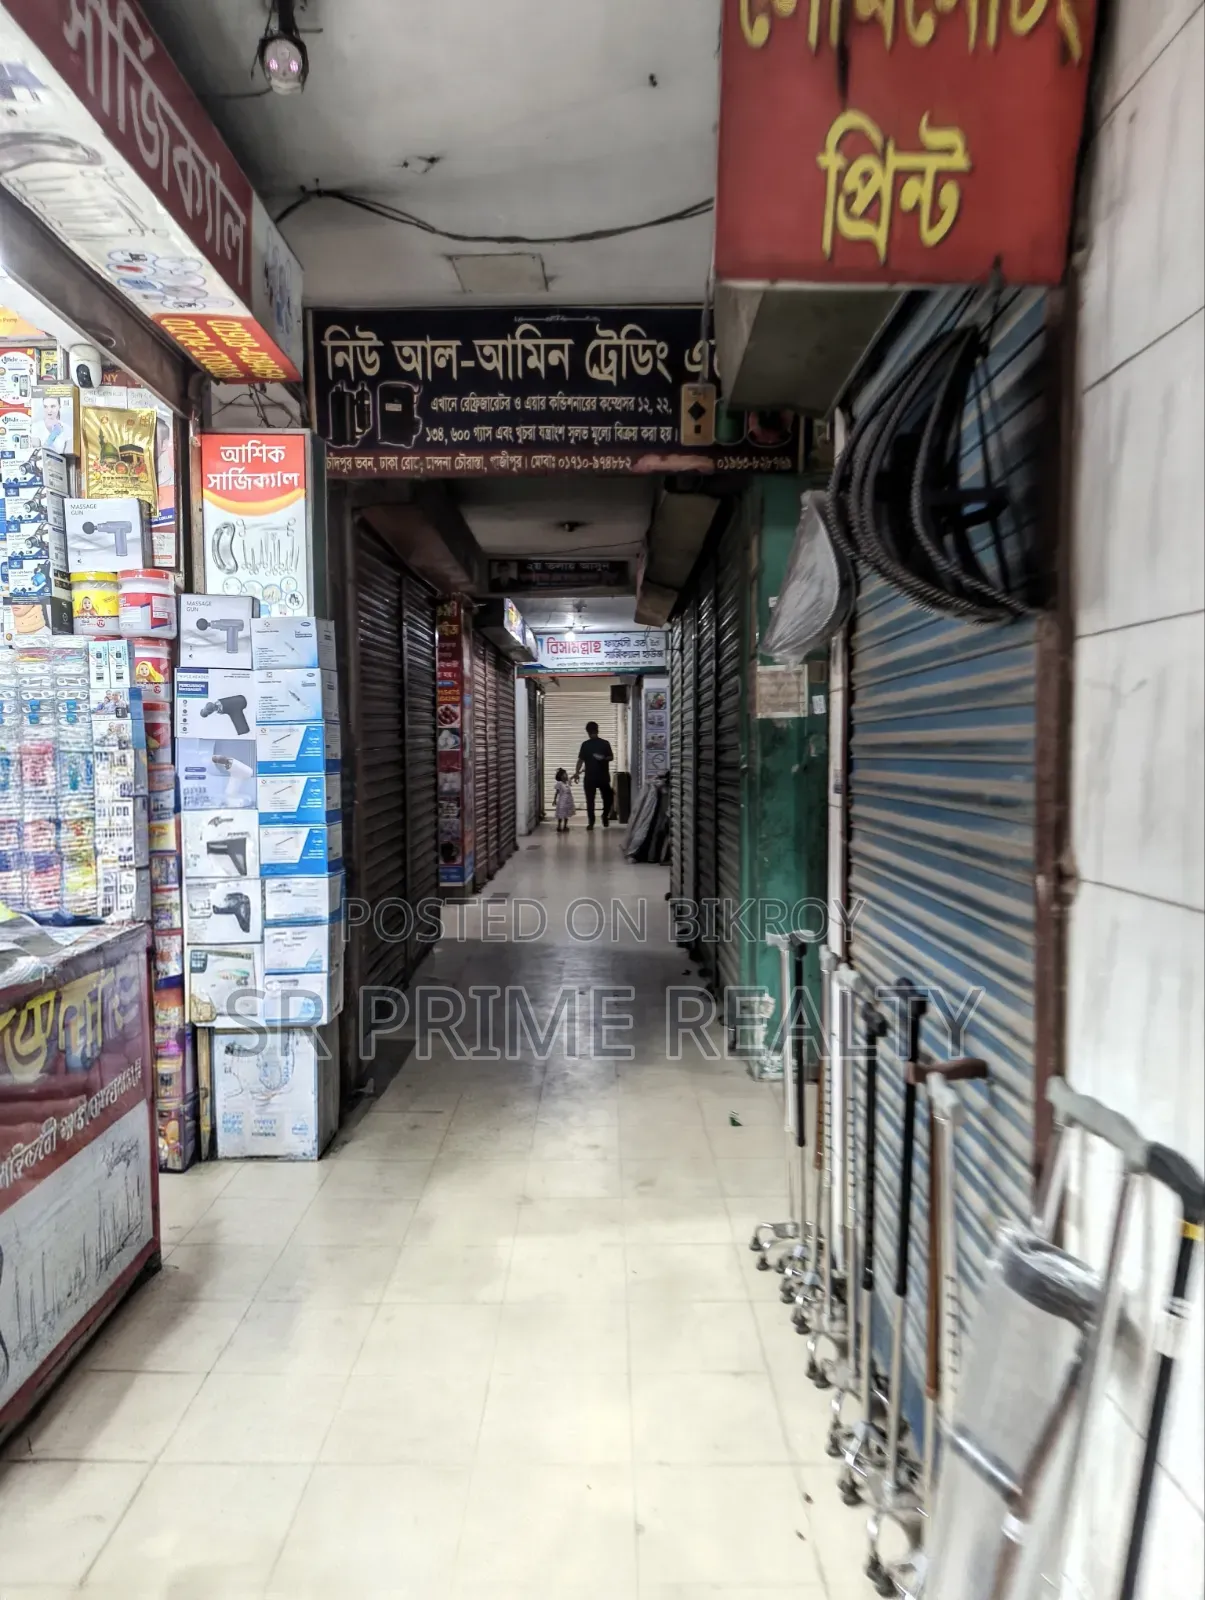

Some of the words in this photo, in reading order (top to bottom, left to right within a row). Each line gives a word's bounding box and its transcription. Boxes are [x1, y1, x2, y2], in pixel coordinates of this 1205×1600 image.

[816, 108, 972, 266] প্রিন্ট
[321, 325, 384, 381] নিউ
[392, 323, 575, 381] আল-আমিন
[585, 323, 673, 387] ট্রেডিং
[430, 396, 457, 413] এখানে
[460, 393, 511, 414] রেফ্রিজারেটর
[513, 398, 521, 410] ও
[425, 426, 449, 445] ১৩৪,
[450, 427, 471, 442] ৬০০
[473, 426, 493, 442] গ্যাস
[495, 426, 514, 442] এবং
[640, 426, 657, 442] করা
[220, 440, 286, 465] আশিক
[379, 456, 398, 471] ঢাকা
[206, 466, 299, 492] সার্জিক্যাল
